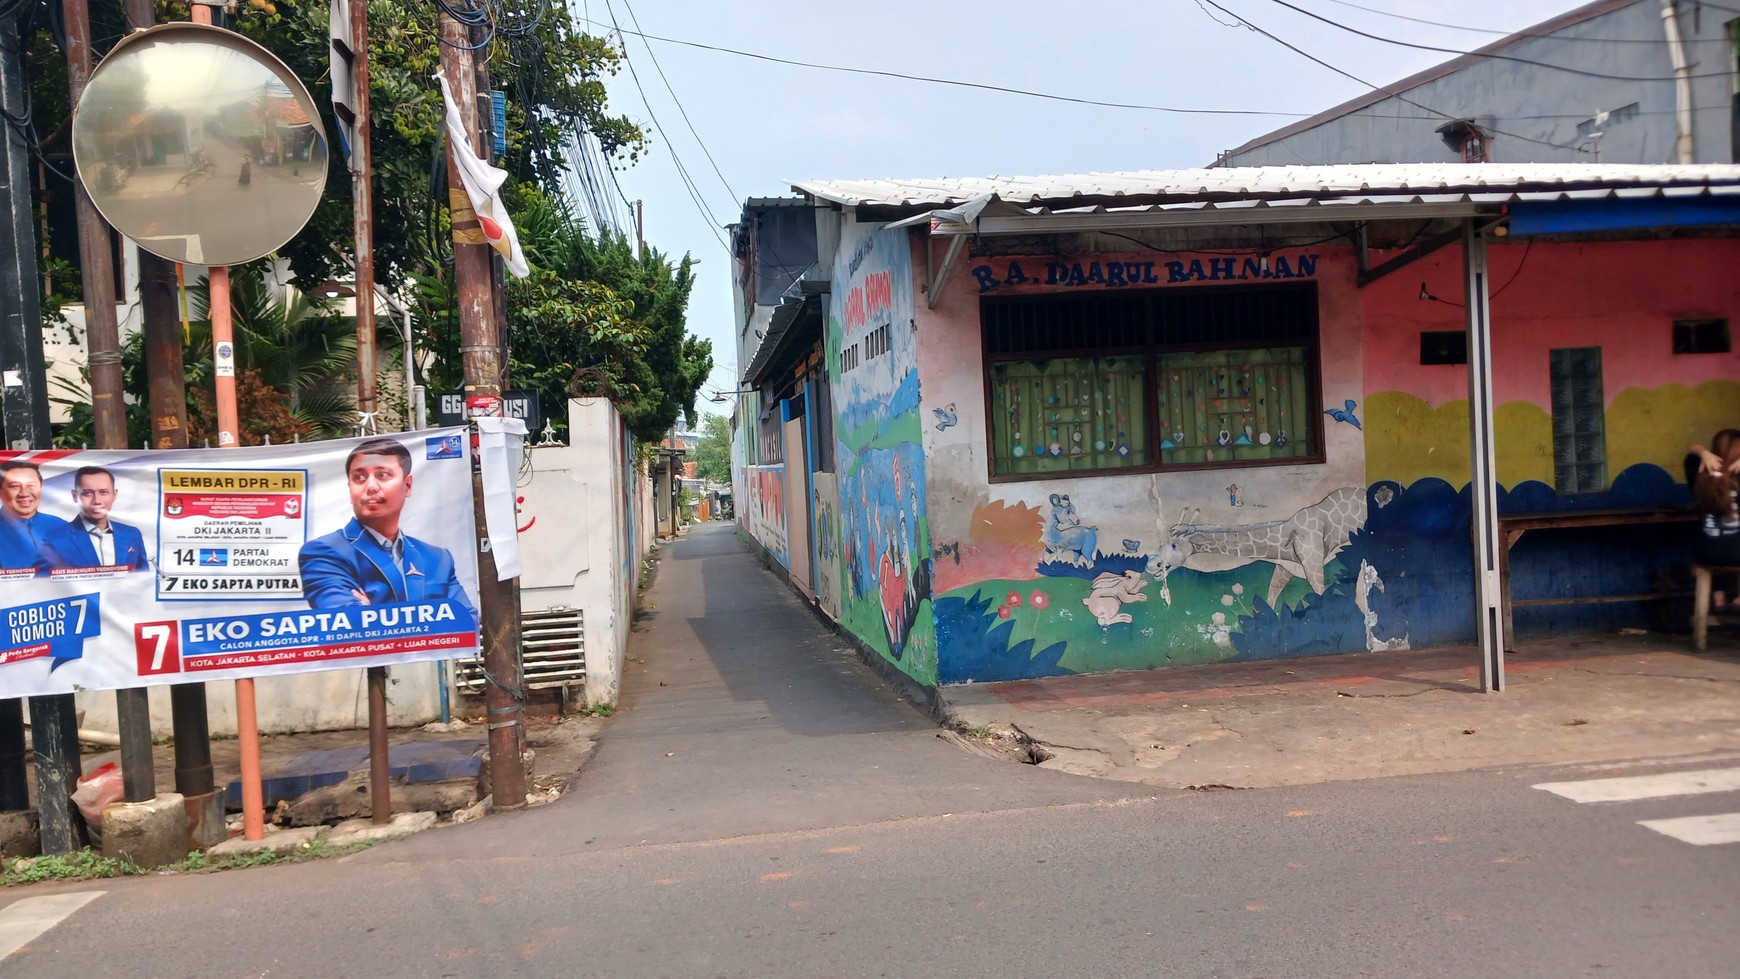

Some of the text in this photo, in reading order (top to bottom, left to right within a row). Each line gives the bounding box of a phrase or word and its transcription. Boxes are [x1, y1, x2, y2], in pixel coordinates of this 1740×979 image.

[1046, 261, 1158, 288] DAARUL
[1164, 254, 1320, 283] RAHMAN
[170, 477, 234, 488] LEMBAR
[238, 478, 269, 488] DPR
[282, 478, 296, 488] RI
[173, 549, 196, 566] 14
[165, 577, 299, 591] 7 EKO SAPTA PUTRA
[8, 603, 66, 628] COBLOS
[70, 599, 87, 634] 7
[188, 603, 455, 642] EKO SAPTA PUTRA
[12, 620, 65, 644] NOMOR
[220, 641, 252, 650] CALON
[254, 638, 299, 647] ANGGOTA
[336, 632, 363, 640] DAPIL
[382, 626, 422, 636] JAKARTA
[141, 625, 171, 670] 7
[216, 656, 255, 666] JAKARTA
[257, 652, 296, 662] SELATAN
[328, 646, 366, 656] JAKARTA
[368, 643, 394, 651] PUSAT
[403, 640, 427, 648] LUAR
[428, 637, 459, 646] NEGERI
